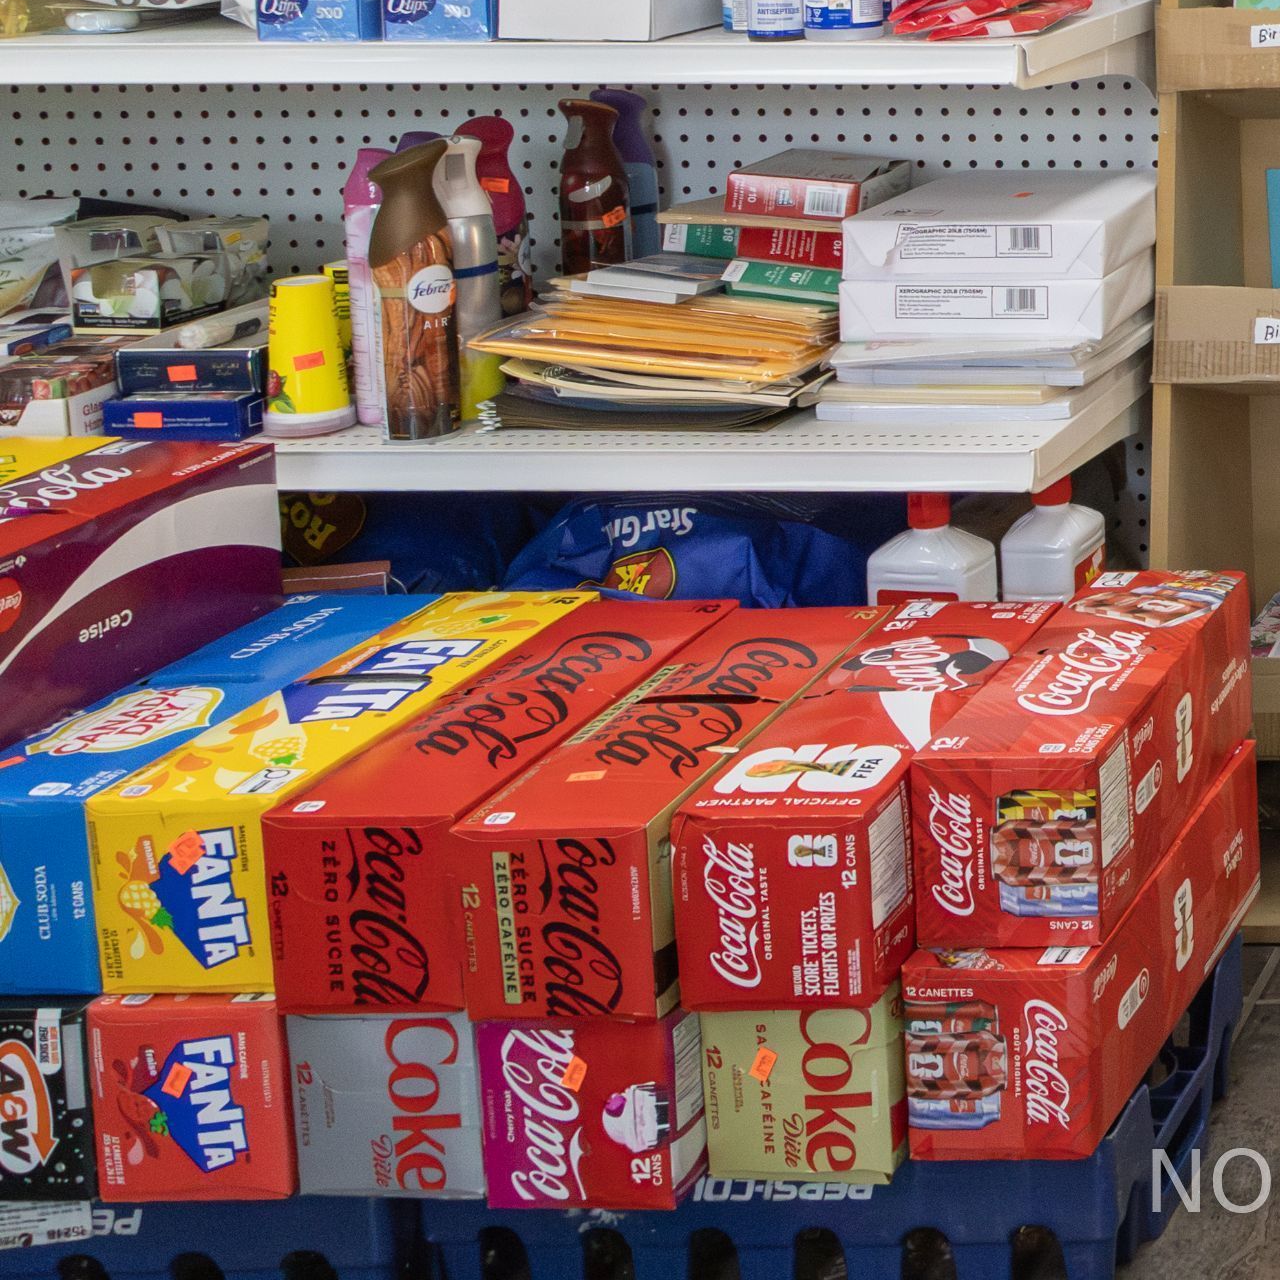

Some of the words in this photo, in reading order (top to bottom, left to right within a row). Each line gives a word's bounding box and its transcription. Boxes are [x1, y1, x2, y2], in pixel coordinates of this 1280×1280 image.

[722, 228, 735, 243] 80
[833, 239, 842, 257] #10
[789, 271, 802, 283] 40
[423, 318, 449, 330] AIR
[78, 608, 134, 640] Cerise
[229, 630, 290, 660] CLUB
[292, 605, 343, 636] SODA
[1016, 627, 1150, 716] Coca-Cola
[48, 684, 186, 757] CANADA
[124, 702, 189, 736] DRY
[930, 736, 961, 751] 12
[853, 755, 886, 781] FIFA
[695, 799, 777, 808] PARTNER
[783, 797, 862, 807] OFFICIAL
[975, 816, 983, 844] TASTE
[844, 833, 857, 868] CANS
[929, 785, 976, 917] Coca-Cola
[977, 845, 986, 891] ORIGINAL
[35, 864, 48, 900] SODA
[270, 871, 290, 898] 12
[320, 840, 339, 904] ZÉRO
[493, 860, 509, 909] ZÉRO
[510, 851, 529, 915] ZÉRO
[760, 867, 769, 903] TASTE
[841, 869, 858, 890] 12
[71, 879, 84, 908] CANS
[191, 825, 250, 969] FANTA
[460, 883, 481, 910] 12
[702, 832, 763, 989] Coca-Cola
[818, 891, 837, 930] PRIZES
[39, 902, 52, 940] CLUB
[764, 905, 774, 961] ORIGINAL
[800, 906, 820, 960] TICKETS,
[1049, 920, 1079, 930] CANS
[1081, 921, 1095, 930] 12
[324, 914, 345, 993] SUCRE
[499, 913, 520, 995] CAFÉINE
[821, 931, 838, 949] OR
[517, 926, 538, 1005] SUCRE
[804, 962, 822, 996] SCORE
[822, 949, 840, 997] FLIGHTS
[905, 986, 917, 997] 12
[918, 987, 974, 998] CANETTES
[296, 1060, 313, 1088] 12
[705, 1045, 723, 1069] 12
[1023, 998, 1071, 1131] Coca-Cola
[800, 1008, 873, 1174] Coke
[1013, 1054, 1021, 1099] ORIGINAL
[182, 1036, 249, 1170] FANTA
[385, 1018, 462, 1192] Coke
[505, 1090, 513, 1112] Float
[708, 1072, 720, 1131] CANETTES
[506, 1112, 516, 1143] Cherry
[782, 1112, 804, 1169] Diète
[630, 1157, 651, 1184] 12
[651, 1153, 663, 1187] CANS
